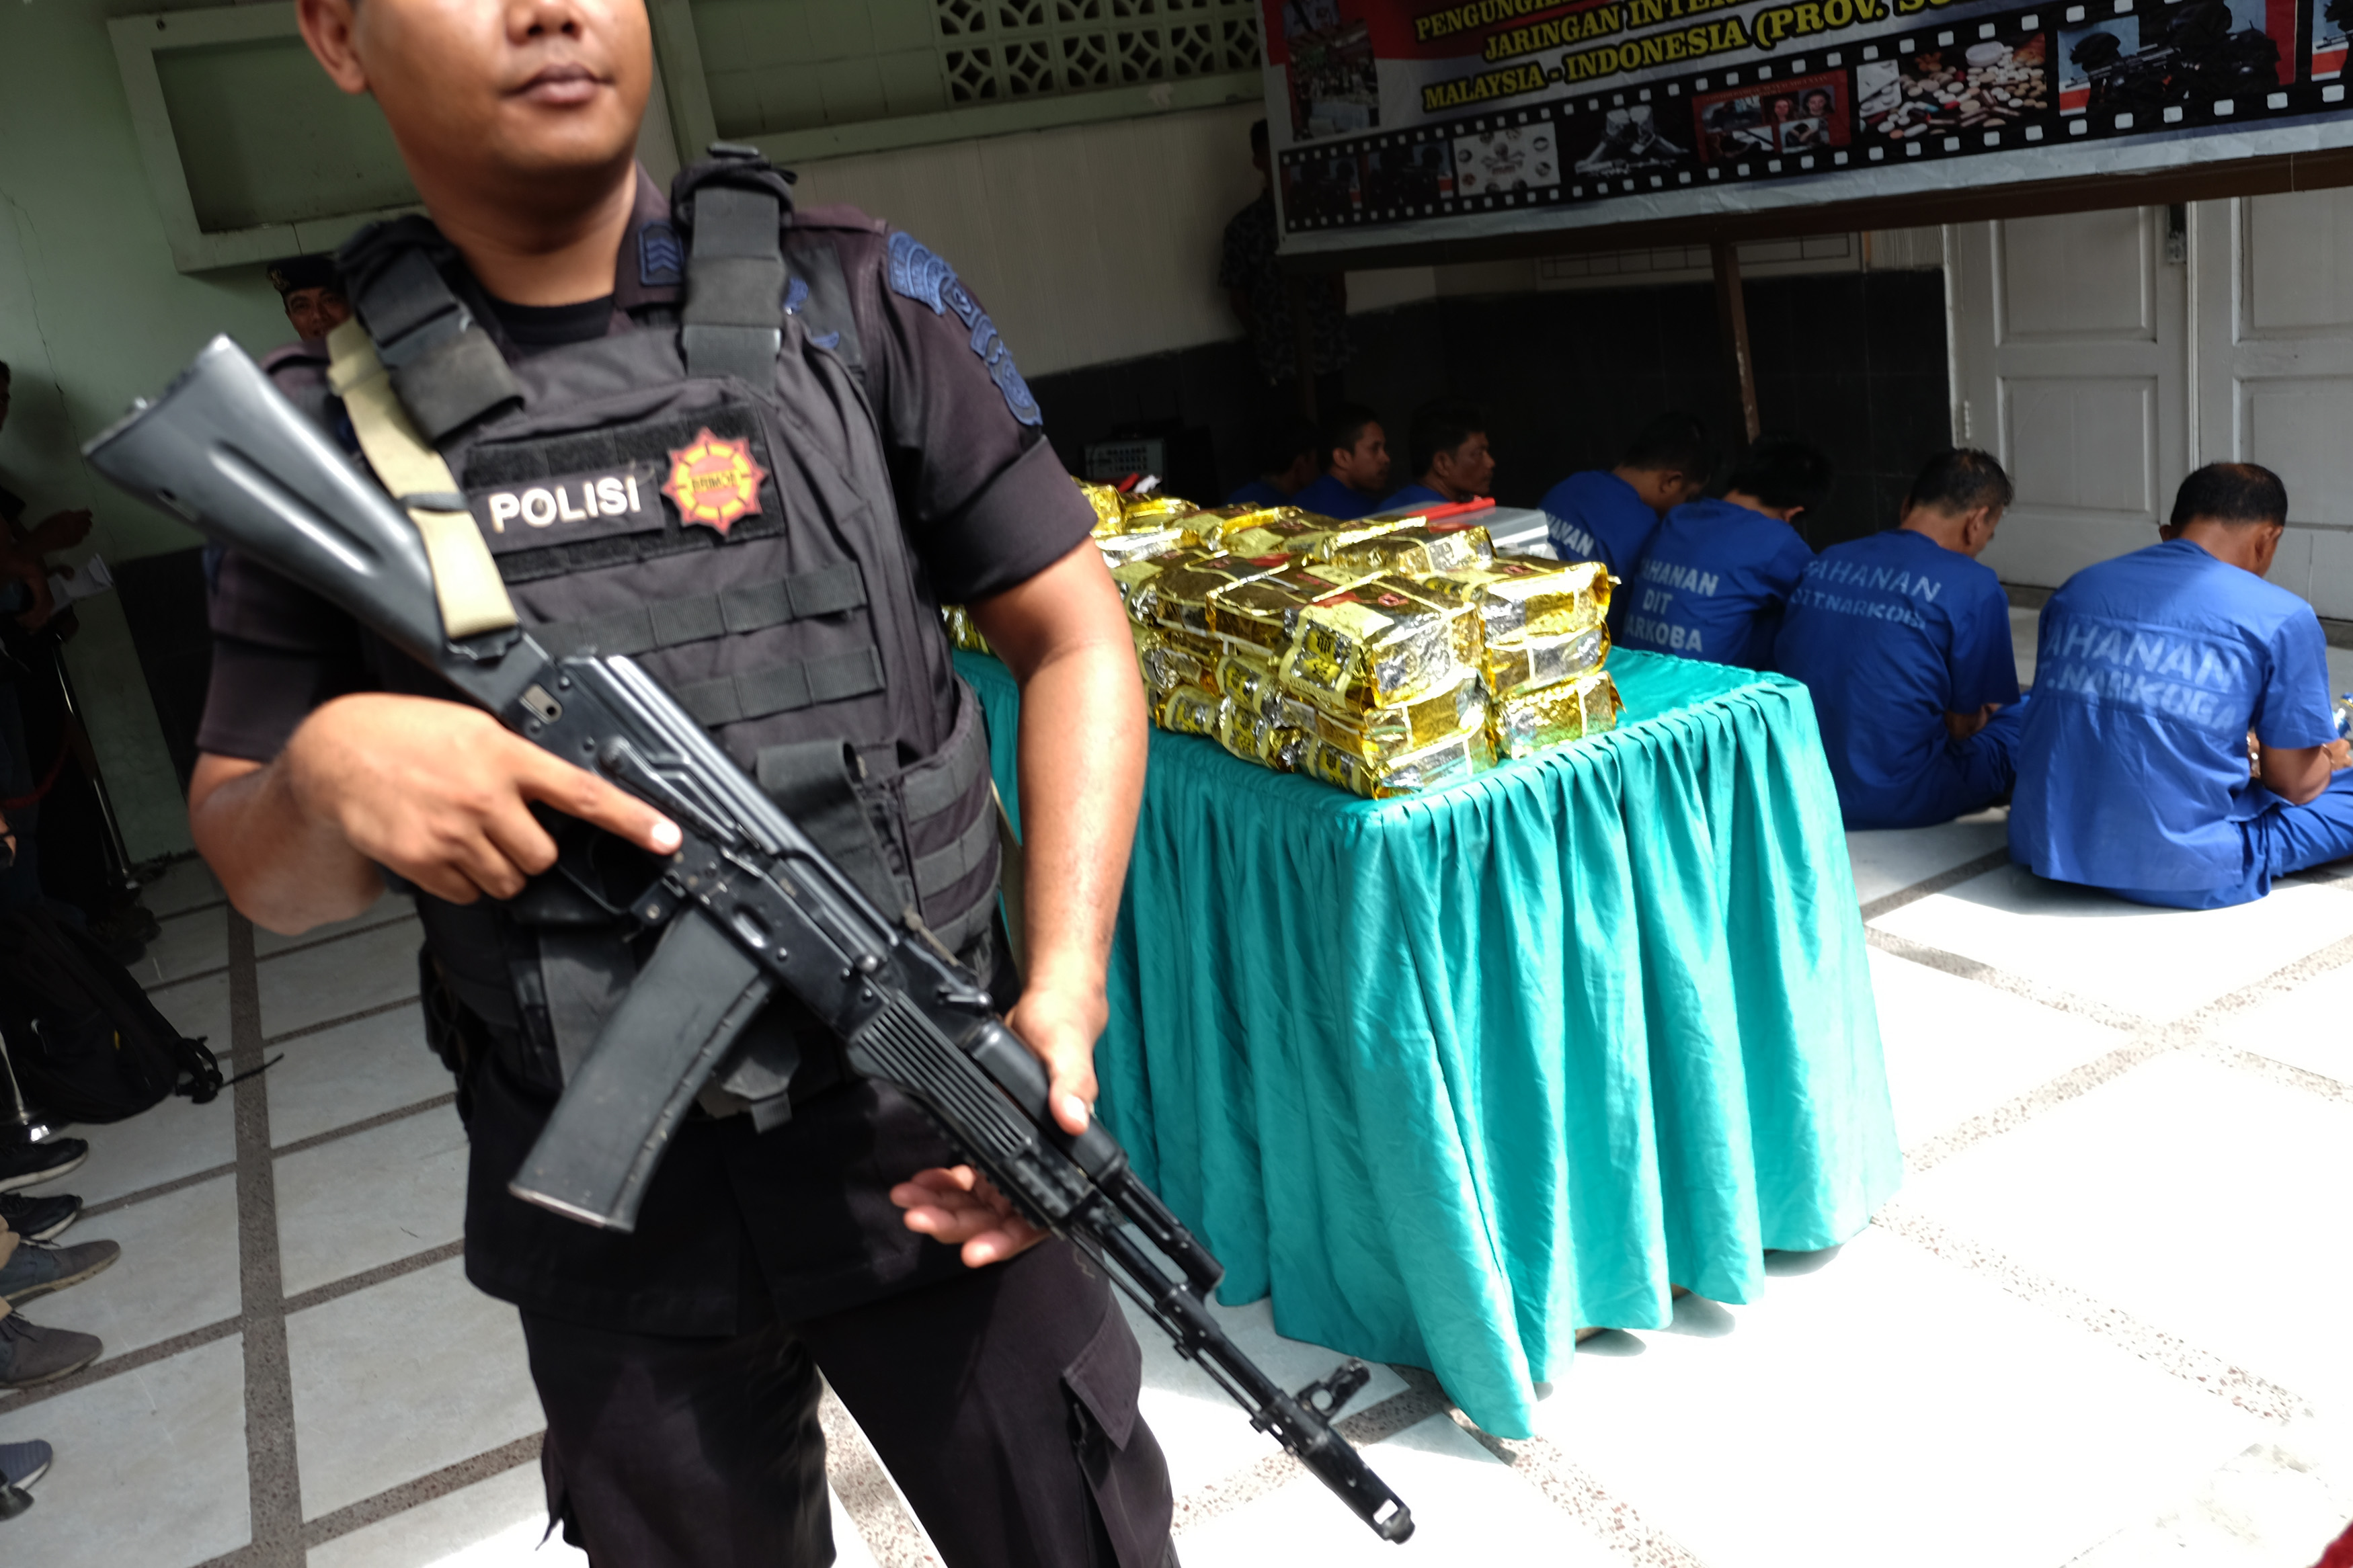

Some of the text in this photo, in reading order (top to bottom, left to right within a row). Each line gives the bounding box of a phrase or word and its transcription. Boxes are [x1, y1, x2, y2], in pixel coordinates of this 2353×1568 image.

[1424, 64, 1546, 110] MALAYSIA
[1565, 19, 1748, 81] INDONESIA
[1757, 0, 1884, 47] (PROV.
[1485, 5, 1620, 60] JARINGAN
[489, 474, 641, 534] POLISI
[1642, 589, 1673, 615] DIT
